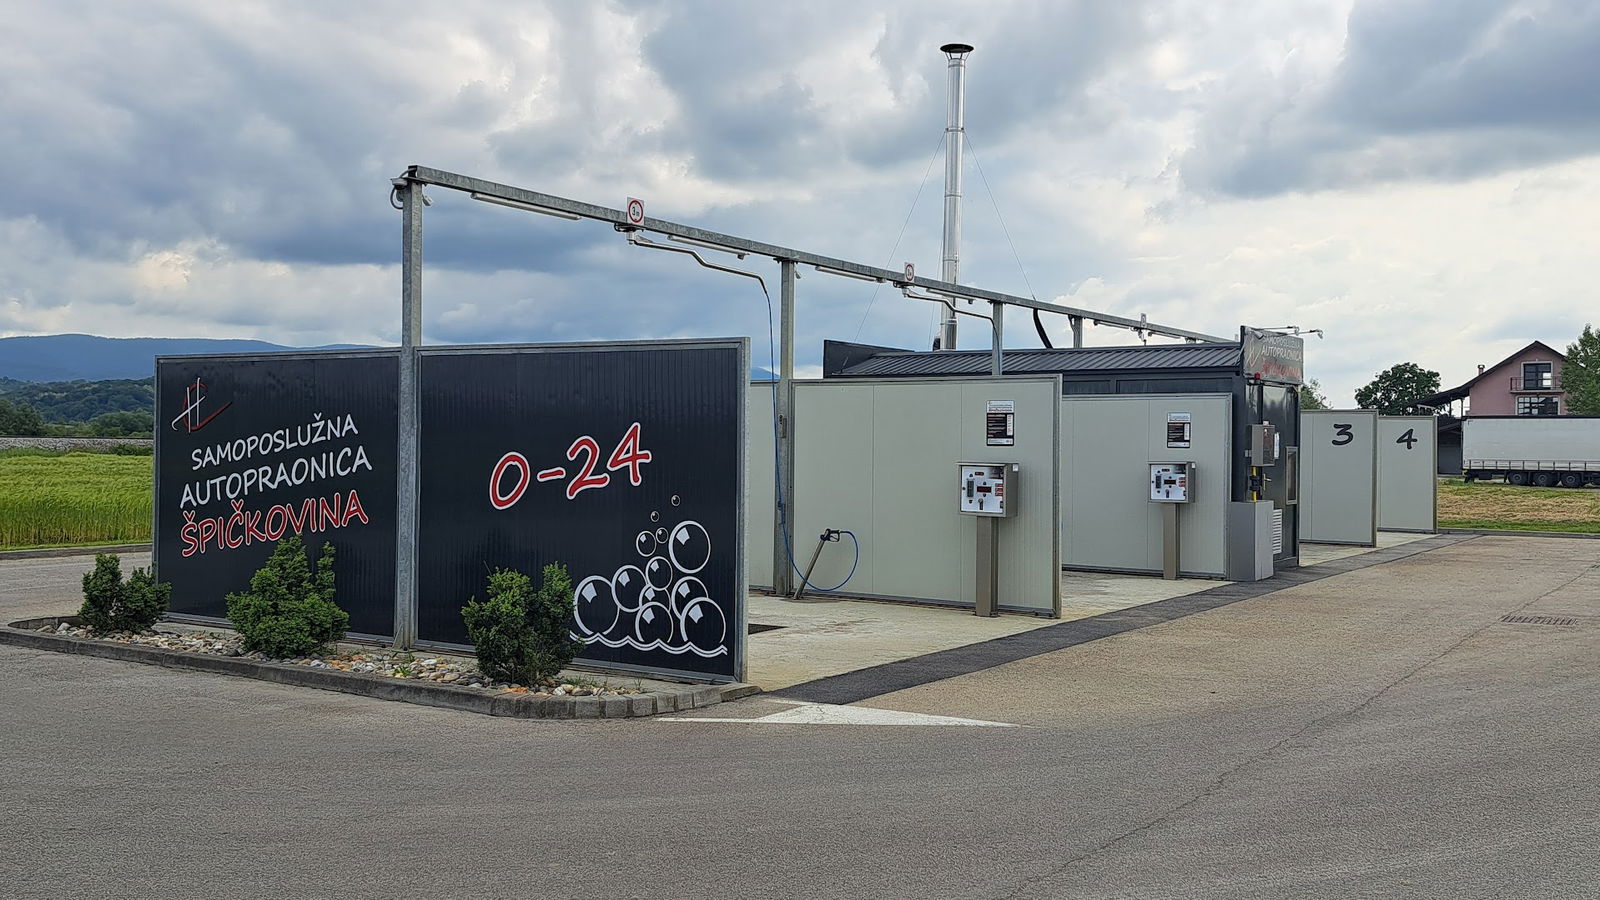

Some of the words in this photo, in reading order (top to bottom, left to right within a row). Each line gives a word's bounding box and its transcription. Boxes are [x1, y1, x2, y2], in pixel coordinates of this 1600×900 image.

[191, 412, 359, 471] SAMOPOSLUŽNA
[1331, 423, 1354, 446] 3
[1395, 428, 1418, 450] 4
[180, 445, 373, 509] AUTOPRAONICA
[489, 422, 652, 510] 0-24
[180, 489, 369, 557] ŠPIČKOVINA
